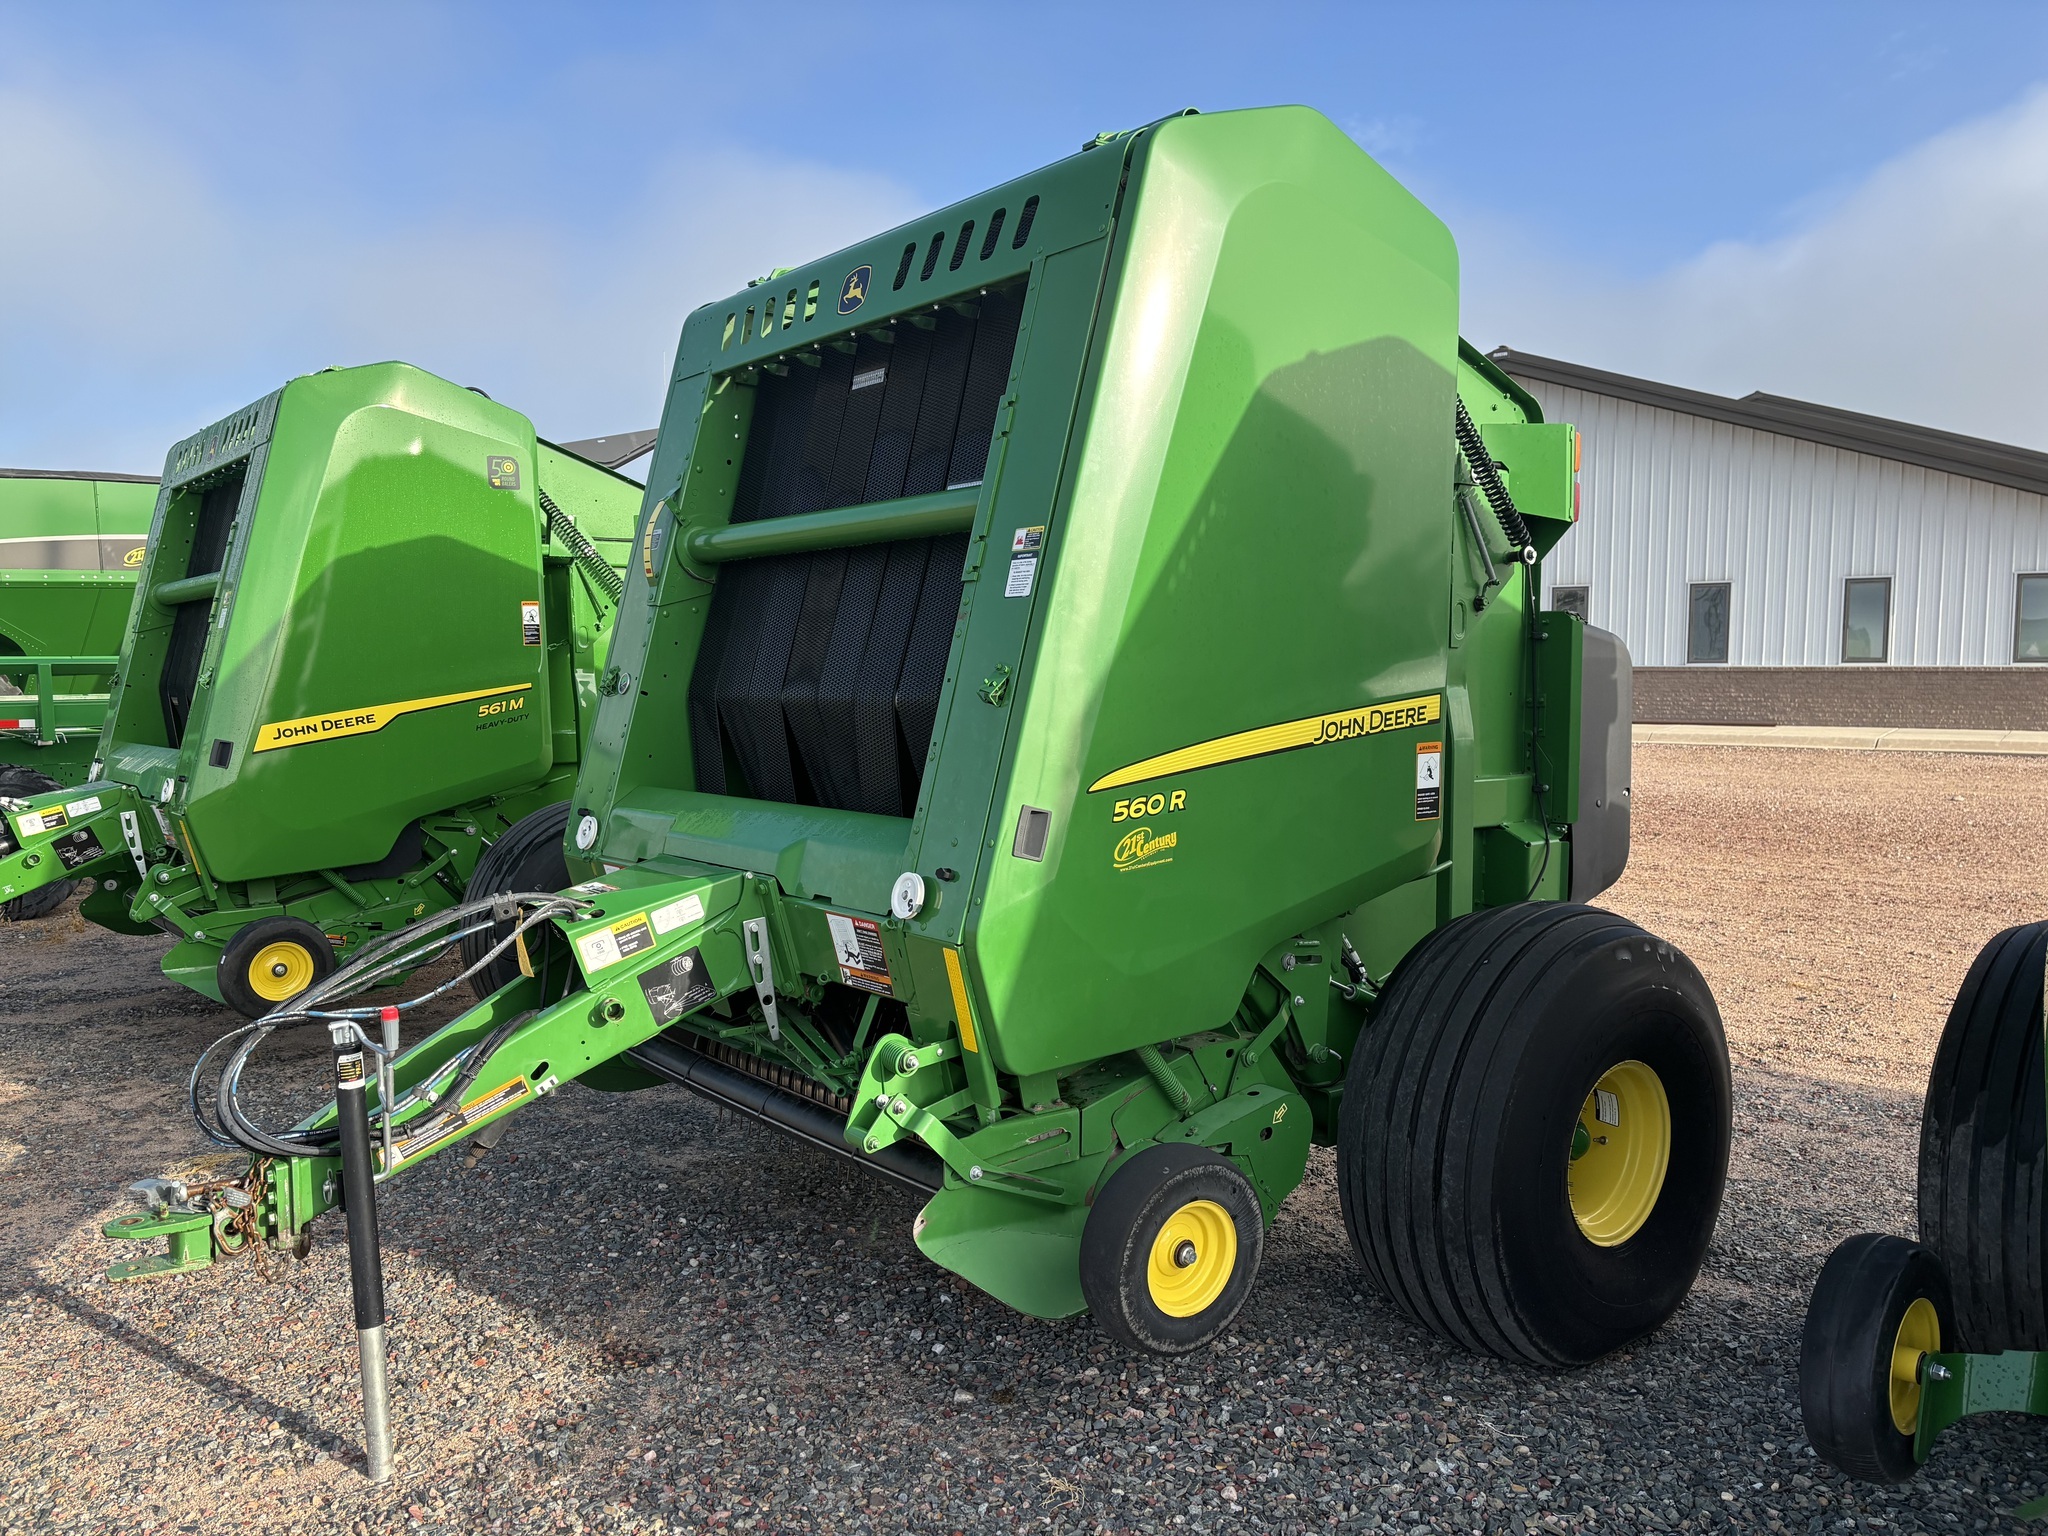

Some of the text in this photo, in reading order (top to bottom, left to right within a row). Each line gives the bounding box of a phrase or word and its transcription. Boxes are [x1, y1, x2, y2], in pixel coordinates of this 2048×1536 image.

[478, 697, 524, 717] 561 M
[273, 713, 377, 740] JOHN DEERE
[475, 713, 530, 731] HEAVY-DUTY
[1313, 705, 1427, 742] JOHN DEERE
[1112, 789, 1187, 823] 560 R
[1122, 831, 1145, 860] 21st
[619, 917, 643, 930] CAUTION
[858, 921, 876, 930] DANGER
